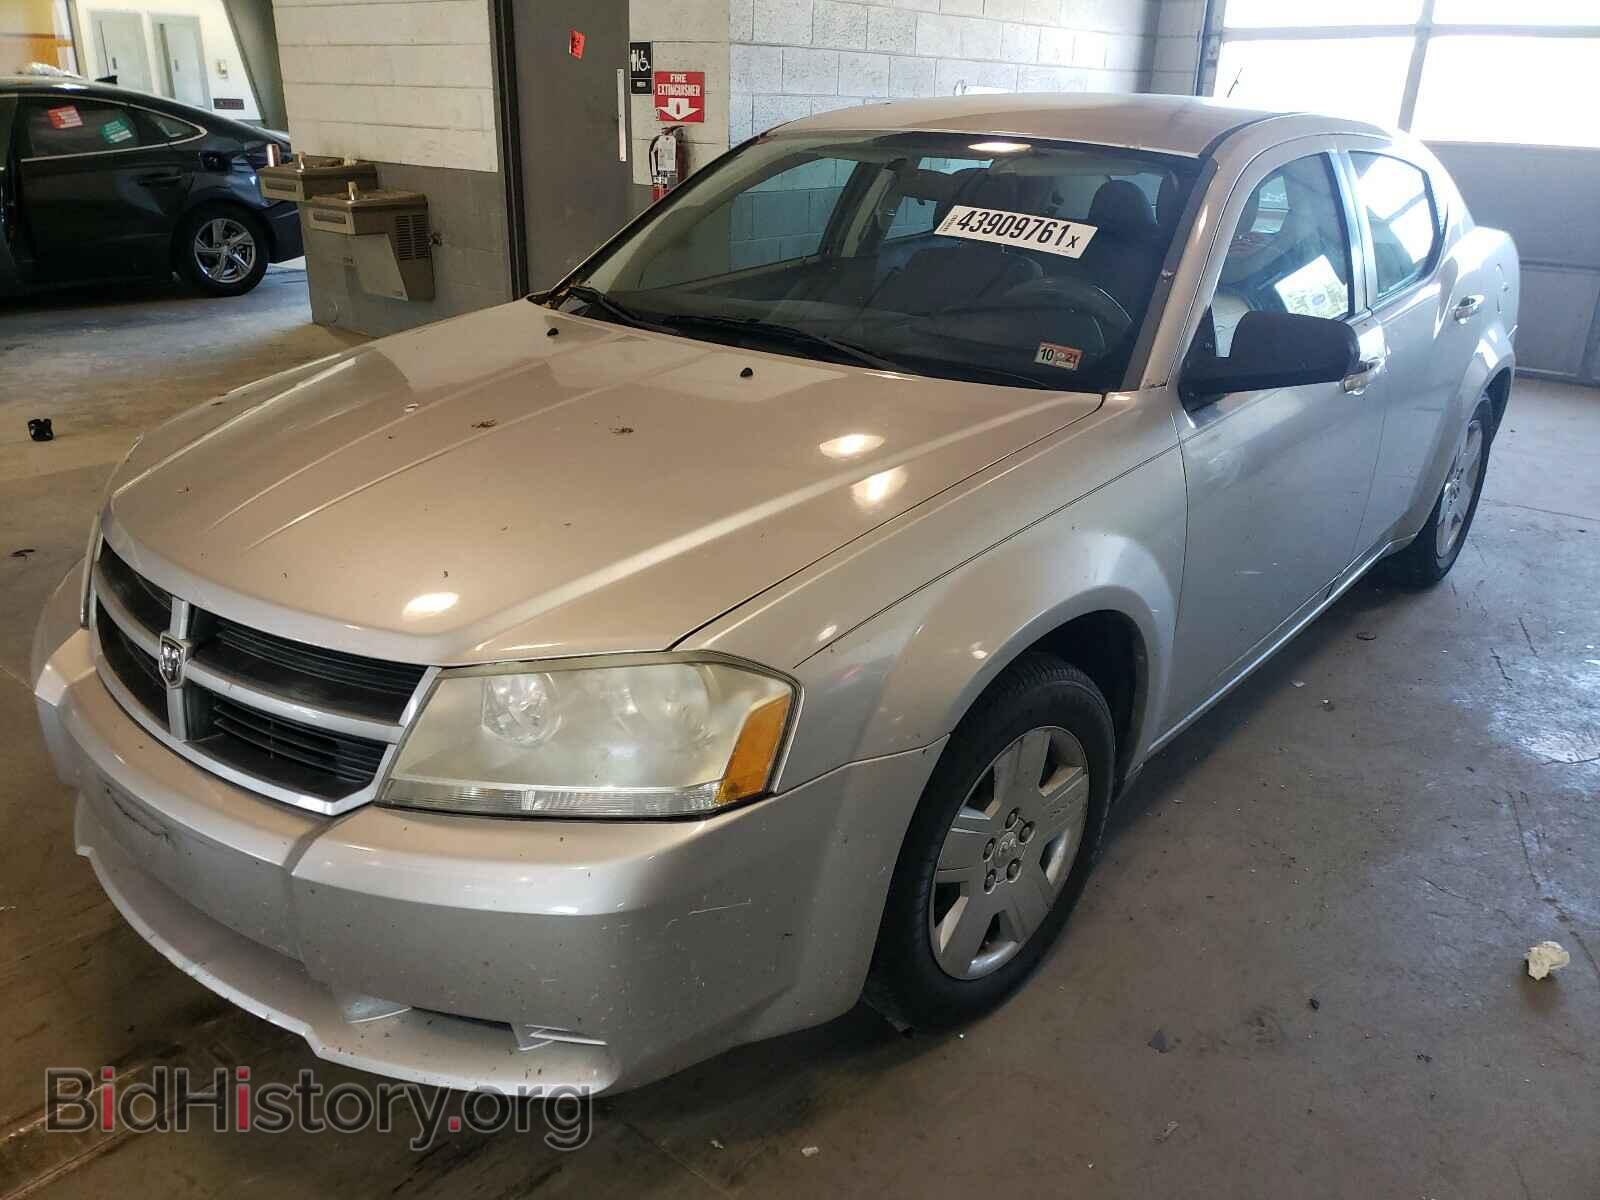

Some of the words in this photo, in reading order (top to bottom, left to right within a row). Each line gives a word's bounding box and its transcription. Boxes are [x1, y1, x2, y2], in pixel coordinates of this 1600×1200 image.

[670, 74, 687, 83] FIRE
[657, 84, 701, 96] EXTINGUISHER
[957, 210, 1071, 247] 43909761
[1040, 348, 1055, 361] 10
